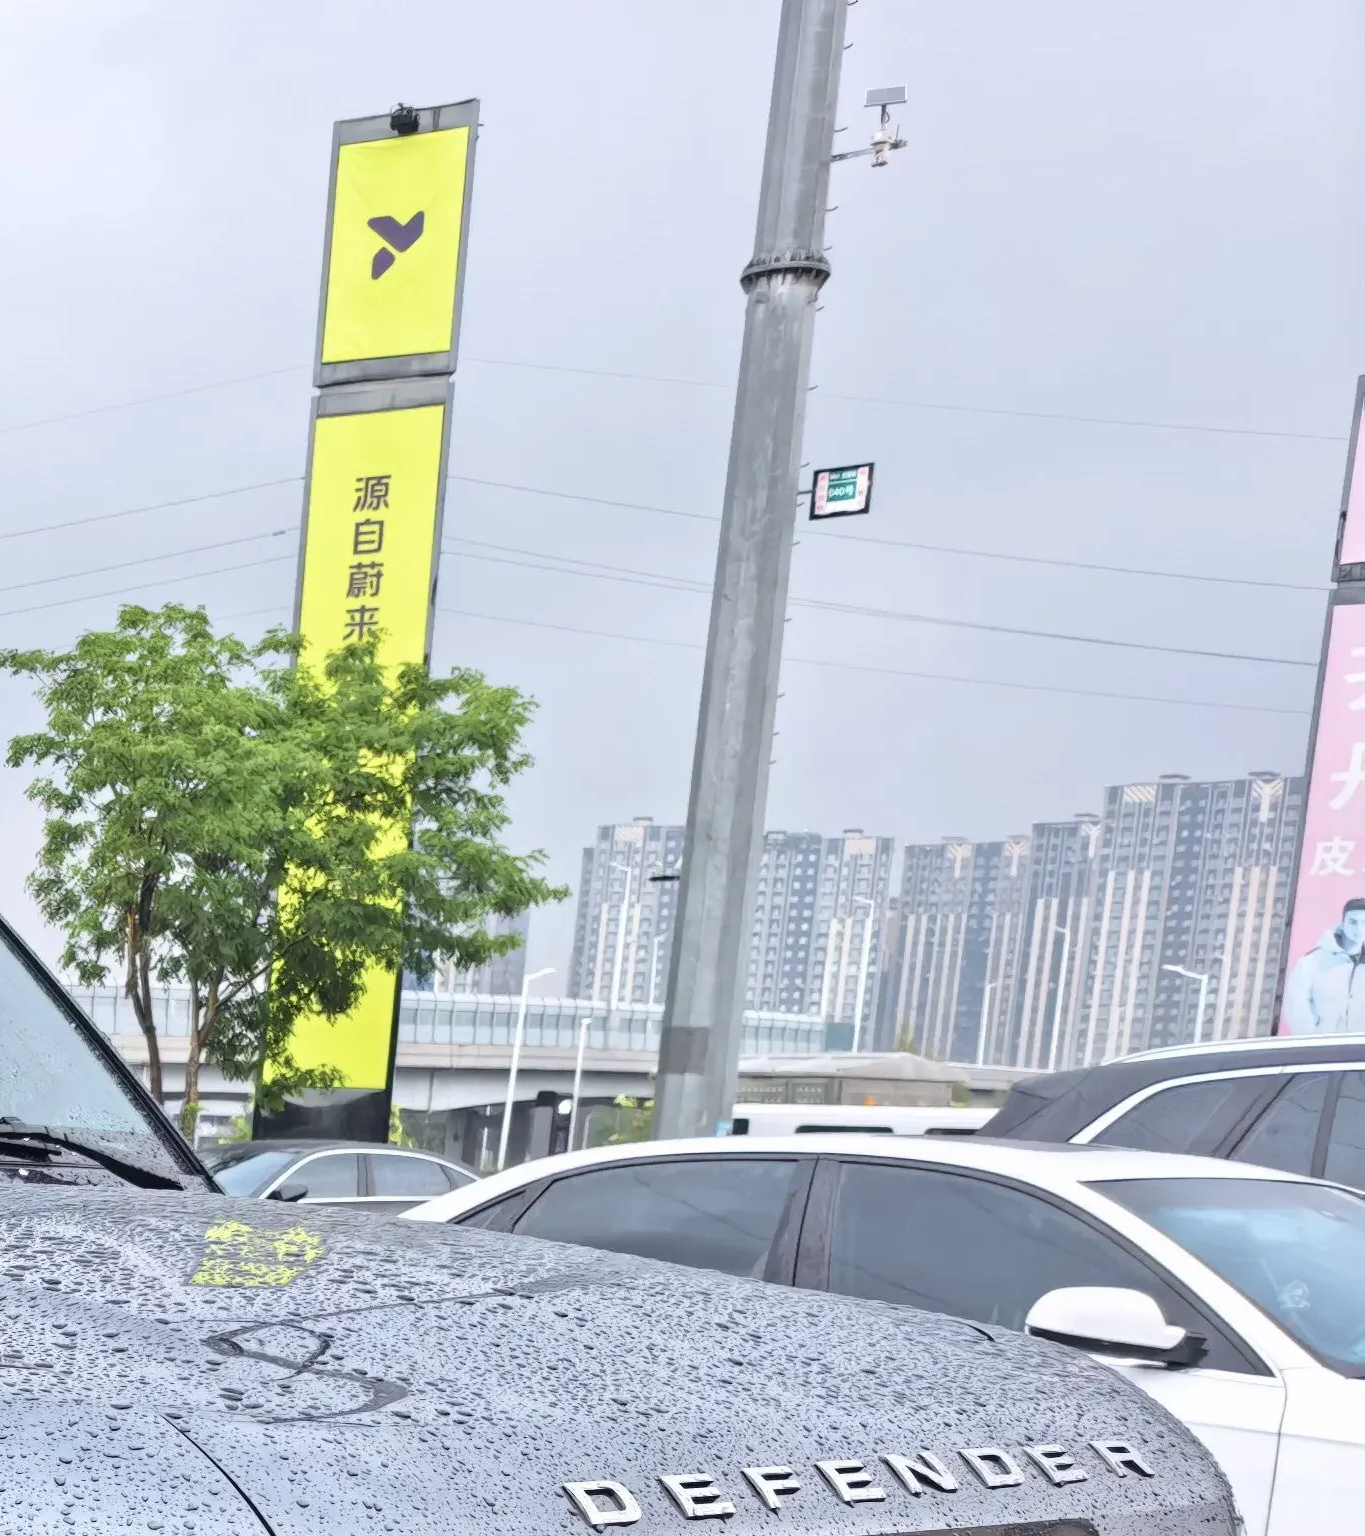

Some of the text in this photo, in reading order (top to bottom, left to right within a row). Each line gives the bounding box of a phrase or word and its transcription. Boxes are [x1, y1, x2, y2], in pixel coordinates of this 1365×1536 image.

[342, 474, 392, 641] 源自蔚来
[565, 1440, 1156, 1527] DEFENDER
